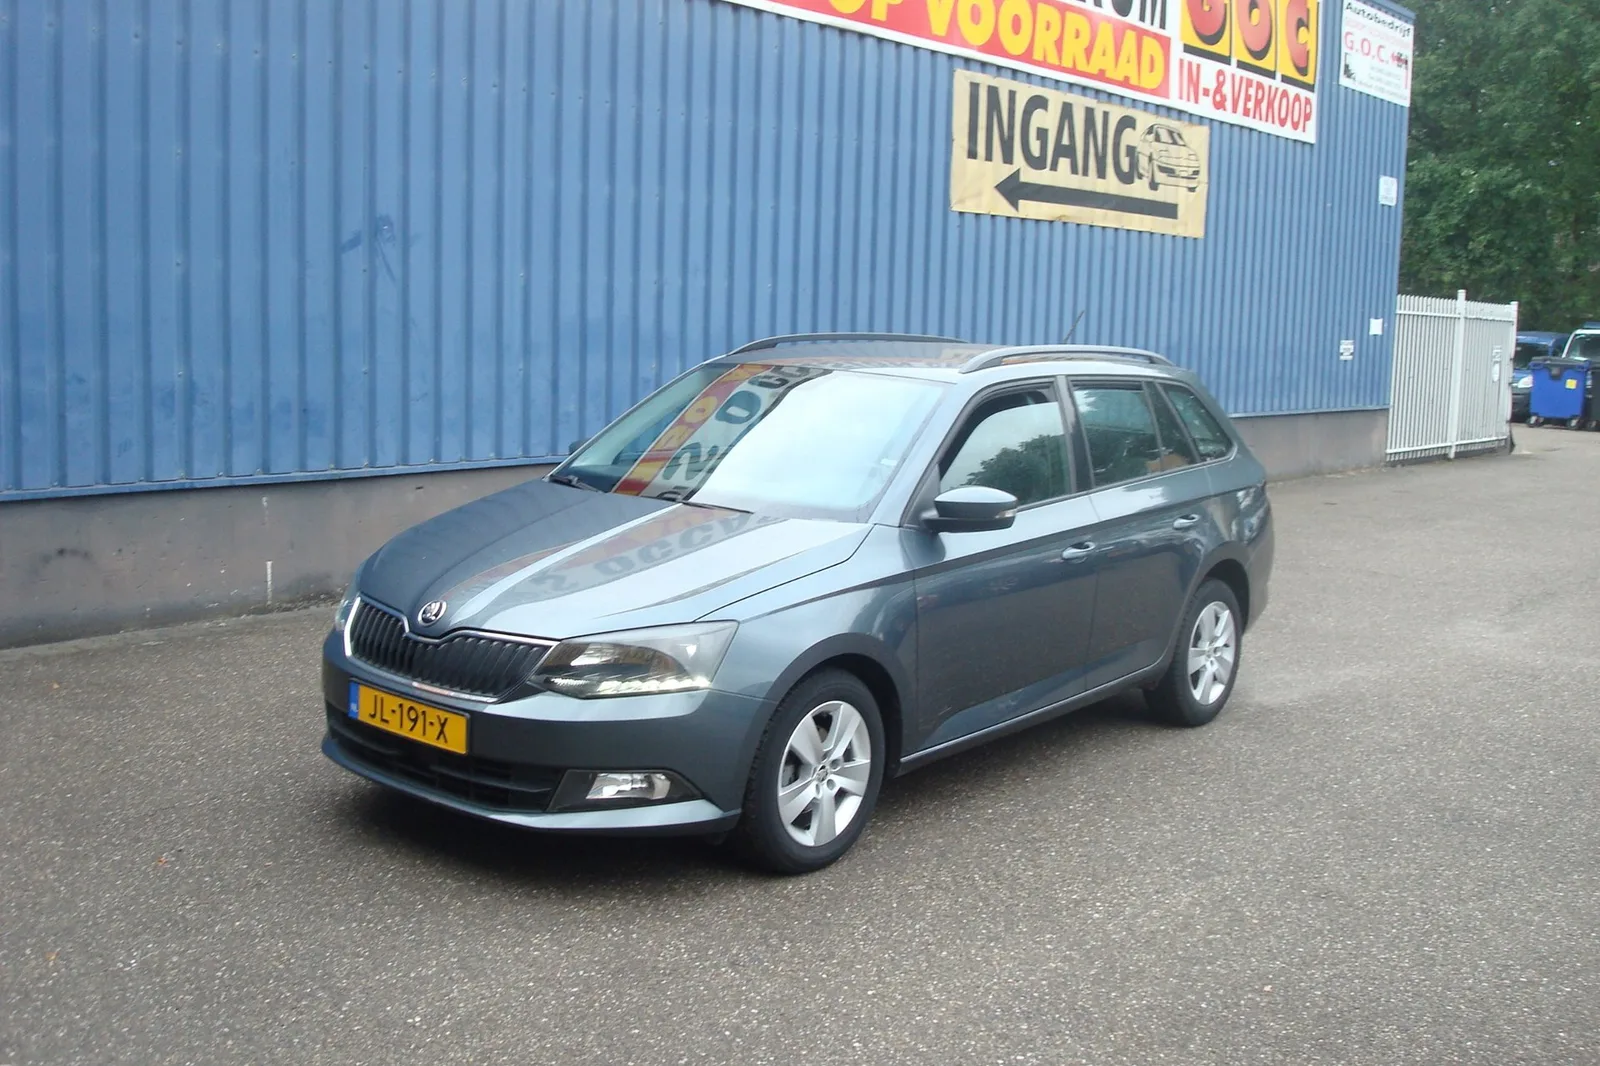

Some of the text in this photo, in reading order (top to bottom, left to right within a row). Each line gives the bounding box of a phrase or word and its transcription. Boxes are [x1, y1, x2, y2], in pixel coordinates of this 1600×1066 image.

[925, 0, 1166, 89] VOORRAAD
[1345, 2, 1411, 38] Autobedrijf
[966, 81, 1137, 185] INGANG
[368, 694, 449, 744] JL-191-X
